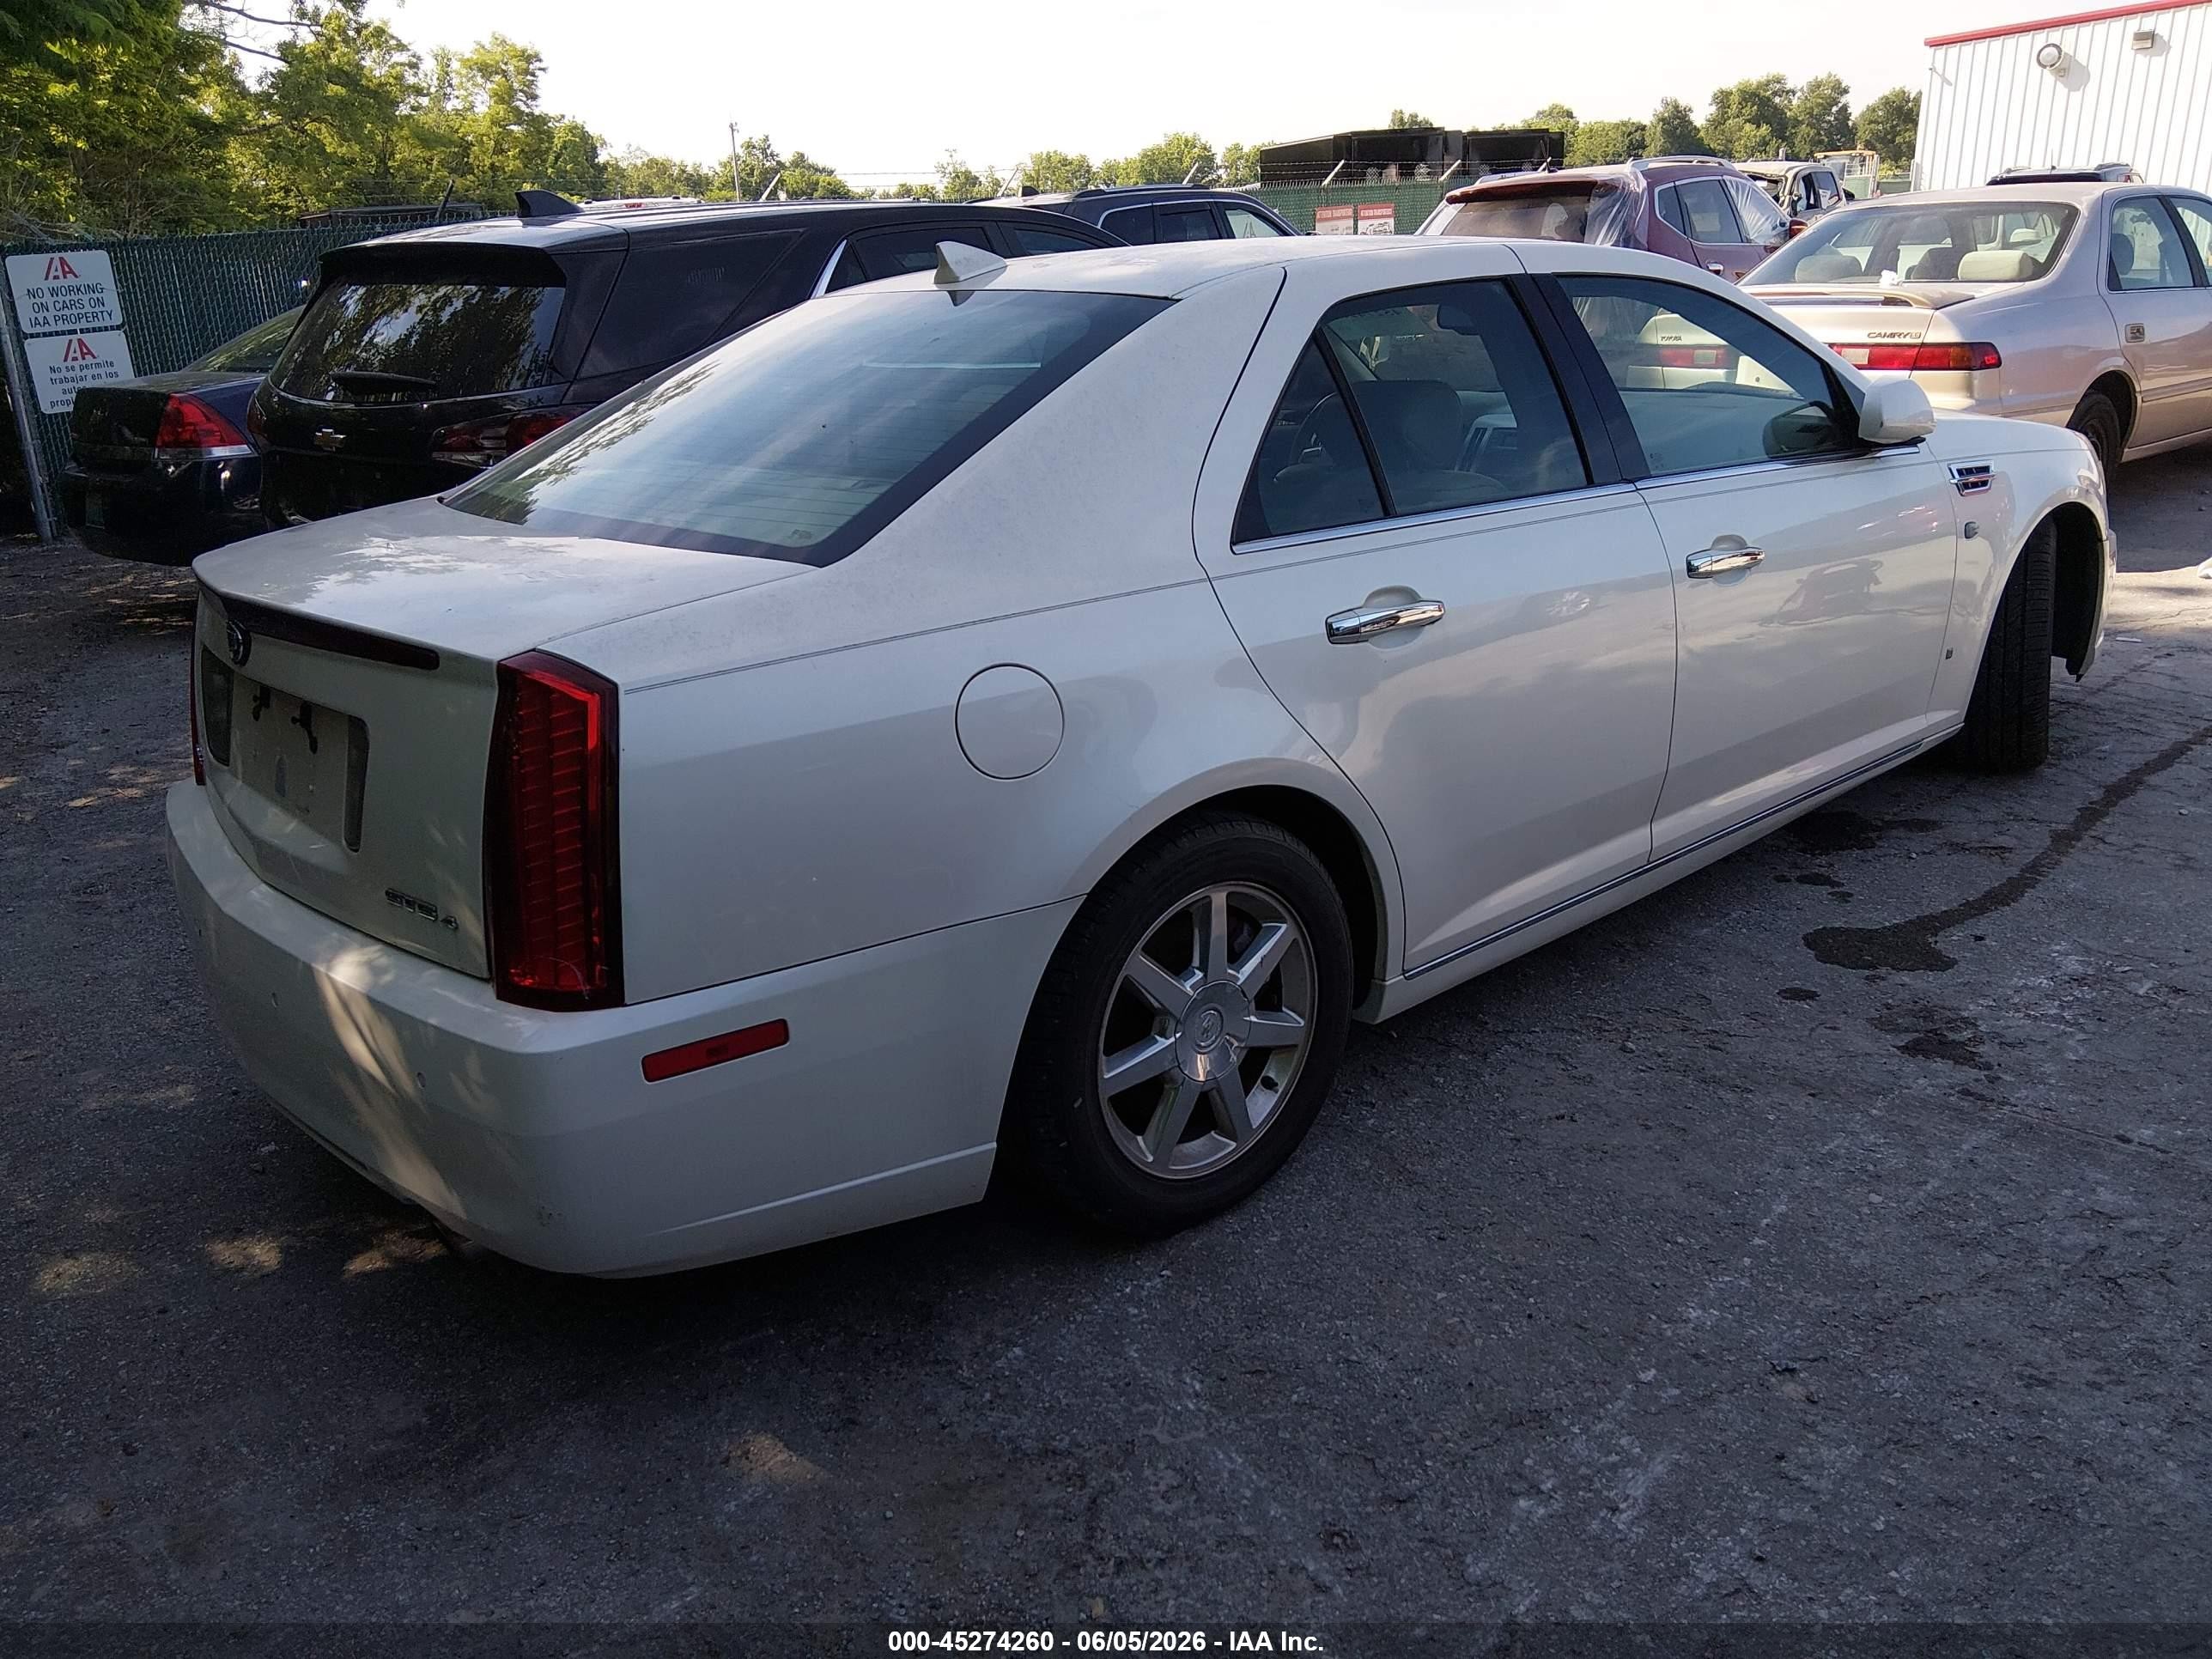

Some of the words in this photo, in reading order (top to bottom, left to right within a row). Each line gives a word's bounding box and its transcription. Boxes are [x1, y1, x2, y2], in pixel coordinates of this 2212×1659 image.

[27, 287, 45, 300] NO
[47, 283, 104, 298] WORKING
[32, 301, 50, 313] ON
[53, 299, 85, 313] CARS
[88, 296, 106, 309] ON
[29, 313, 51, 328] IAA
[54, 310, 113, 326] PROPERTY
[49, 365, 62, 374] No
[65, 364, 76, 373] se
[79, 360, 115, 373] permite
[50, 374, 88, 386] trabajar
[91, 372, 102, 380] en
[105, 370, 119, 380] los
